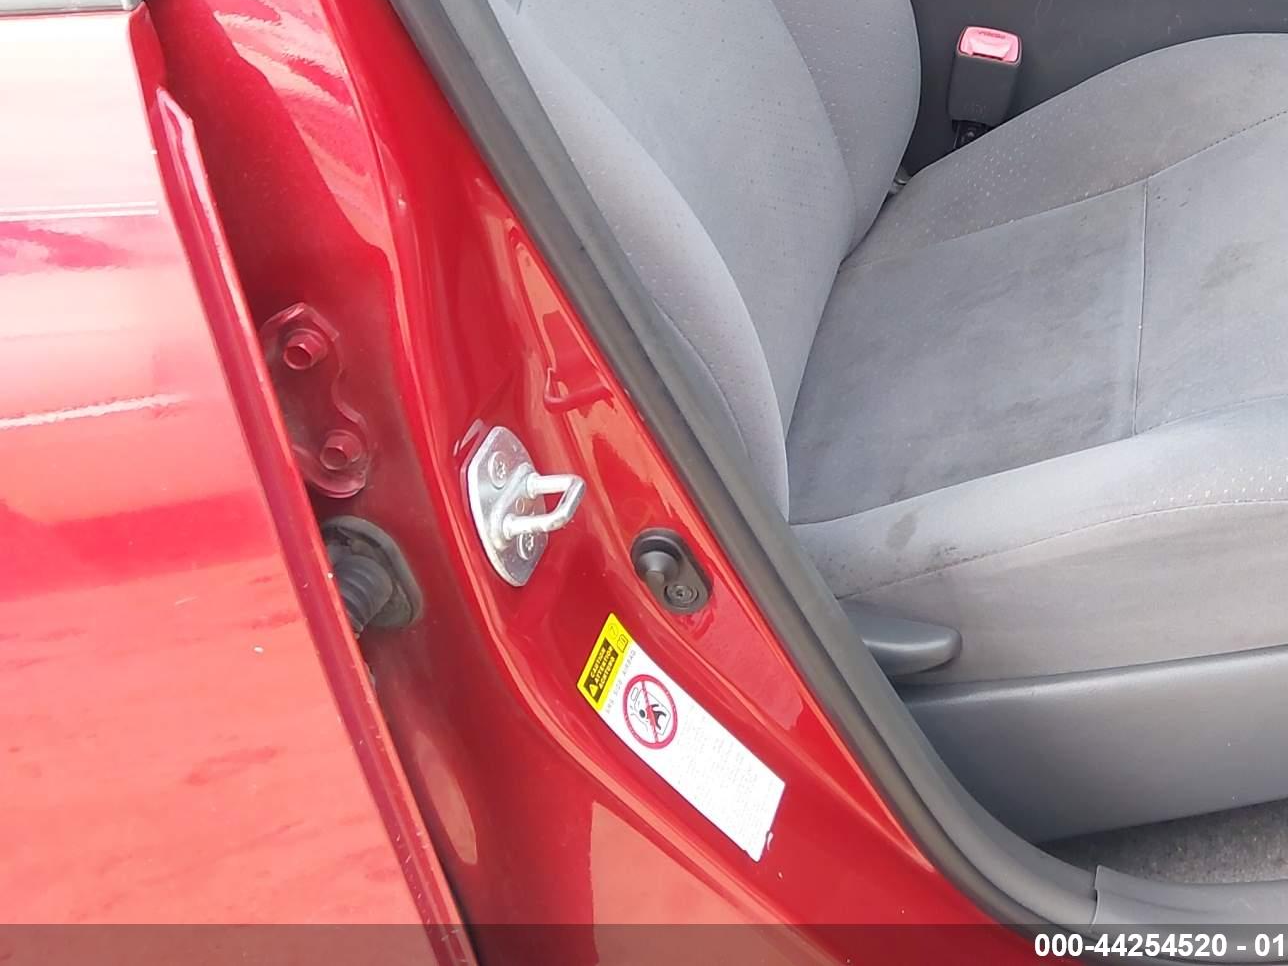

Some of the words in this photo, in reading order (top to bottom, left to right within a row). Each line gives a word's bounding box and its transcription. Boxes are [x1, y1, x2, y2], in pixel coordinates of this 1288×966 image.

[590, 646, 606, 679] CAUTION
[594, 645, 613, 685] ATTENTION
[598, 656, 615, 690] ACHTUNG
